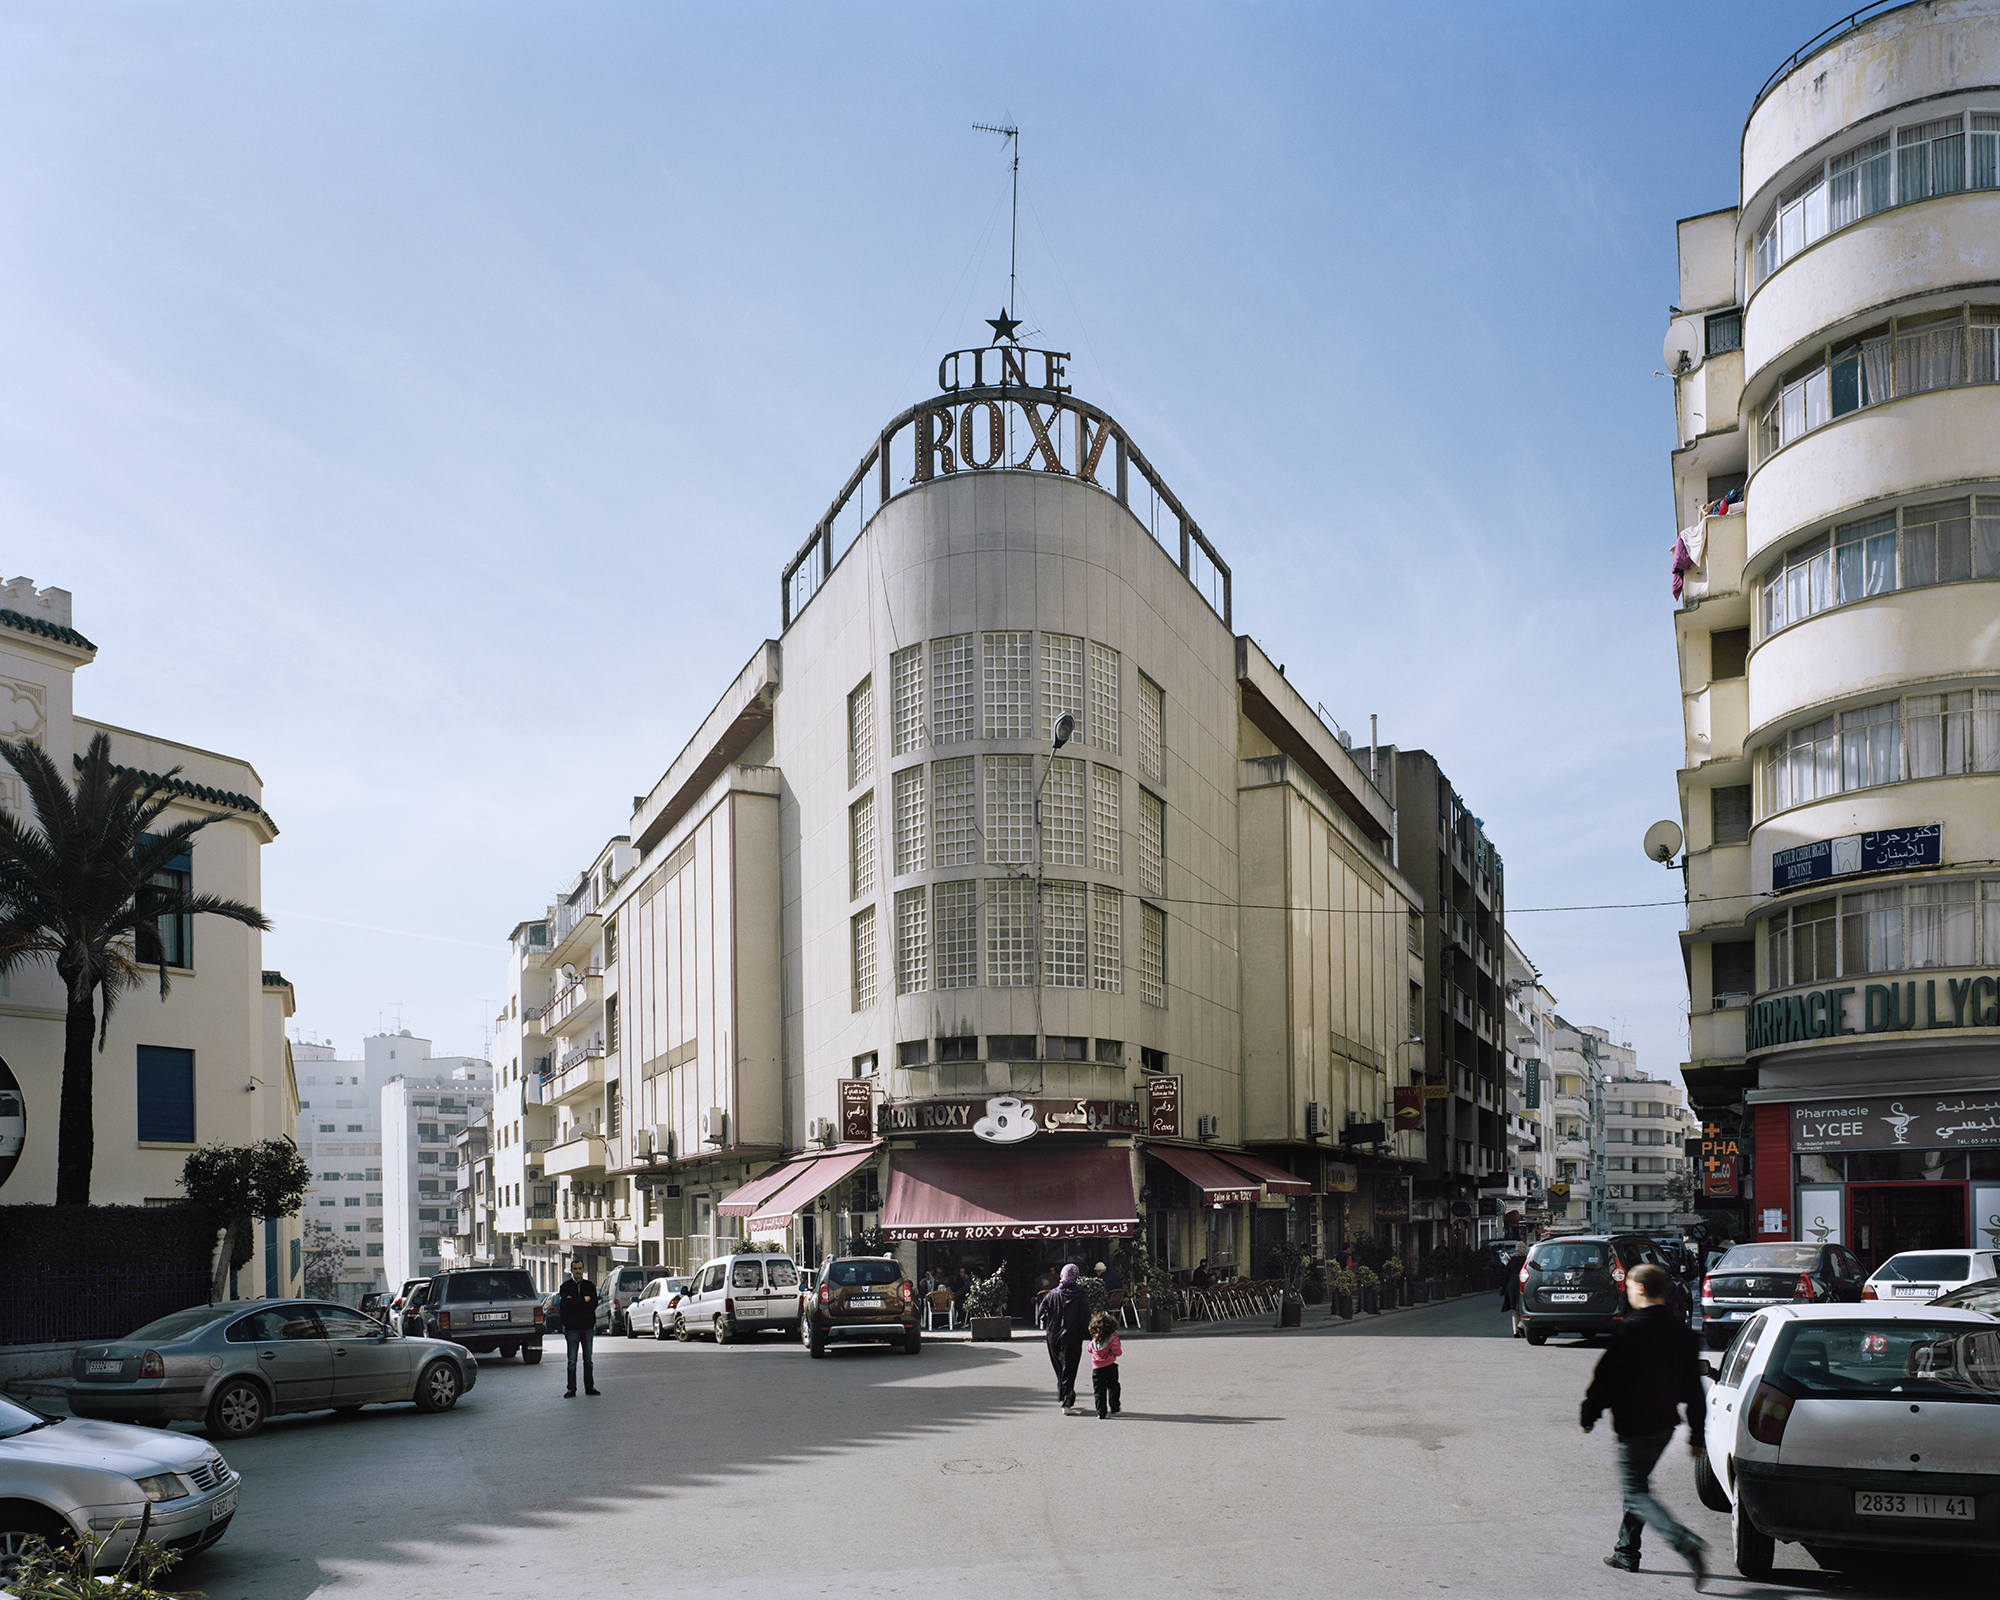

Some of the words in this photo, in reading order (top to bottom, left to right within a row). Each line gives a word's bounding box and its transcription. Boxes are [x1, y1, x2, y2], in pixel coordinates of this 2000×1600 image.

[939, 347, 1071, 394] CINE
[910, 400, 1117, 484] ROXY
[1901, 825, 1939, 843] دكتور
[1774, 851, 1796, 867] DOCTEUR
[1796, 841, 1830, 862] CHIRURGIEN
[1787, 862, 1812, 879] DENTISTE
[1745, 987, 1855, 1051] HARMACIE
[1865, 981, 1916, 1033] DU
[1927, 976, 2000, 1029] LYC
[1423, 1087, 1446, 1097] FOOD
[923, 1104, 971, 1127] ROXY
[1795, 1106, 1870, 1119] Pharmacie
[847, 1122, 868, 1138] Roxy
[1152, 1117, 1175, 1134] Roxy
[1802, 1121, 1863, 1138] LYCEE
[1935, 1116, 2000, 1139] ليسي
[1701, 1140, 1740, 1156] PHA
[889, 1229, 919, 1240] Salon
[923, 1229, 936, 1239] de
[939, 1228, 960, 1239] The
[964, 1226, 1006, 1239] ROXY
[1011, 1225, 1060, 1239] روكسي
[1064, 1224, 1100, 1238] الشاي
[1101, 1223, 1129, 1233] قاعة
[1862, 1495, 1906, 1513] 2833
[1945, 1498, 1968, 1516] 41
